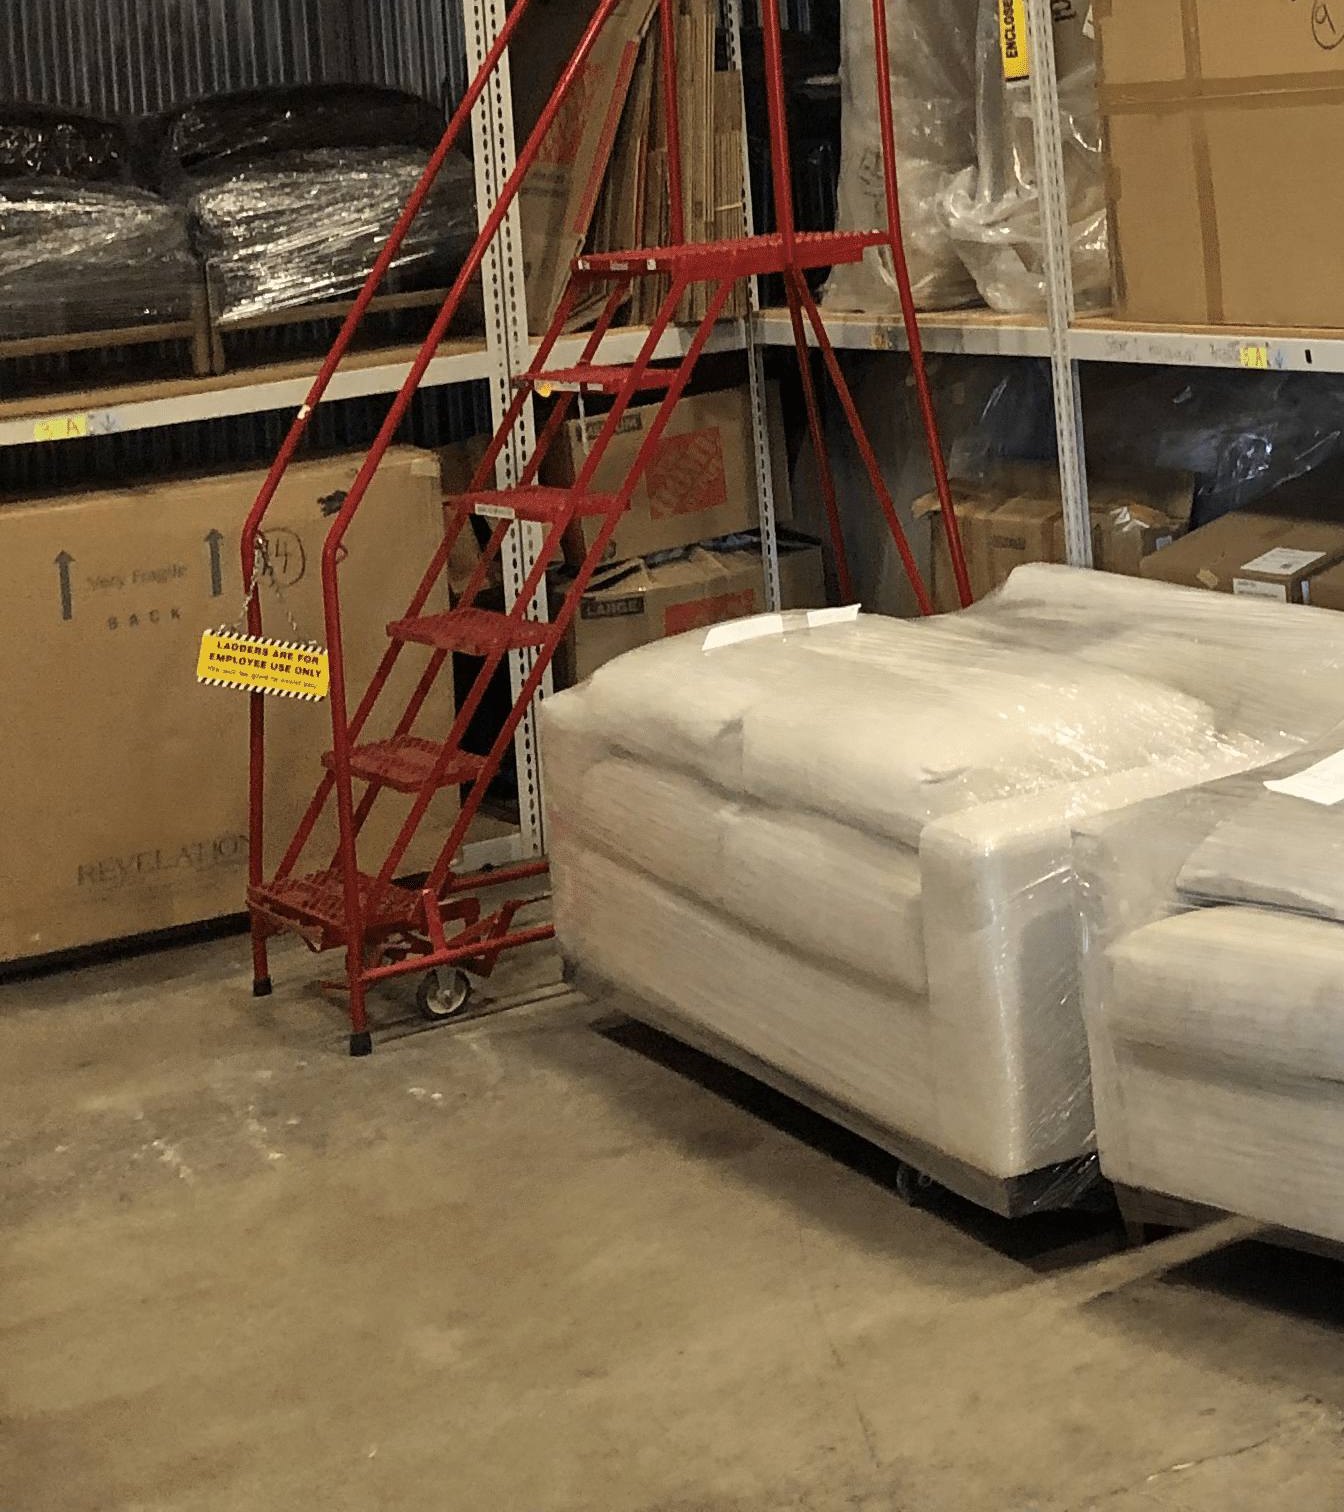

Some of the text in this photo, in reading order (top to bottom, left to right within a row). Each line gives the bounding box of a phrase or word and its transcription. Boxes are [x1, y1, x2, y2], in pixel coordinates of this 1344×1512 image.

[106, 607, 182, 631] BACK
[209, 652, 267, 670] EMPLOYEE
[270, 662, 292, 674] USE
[294, 666, 322, 678] ONLY
[216, 640, 319, 666] LADDERS ARE FOR
